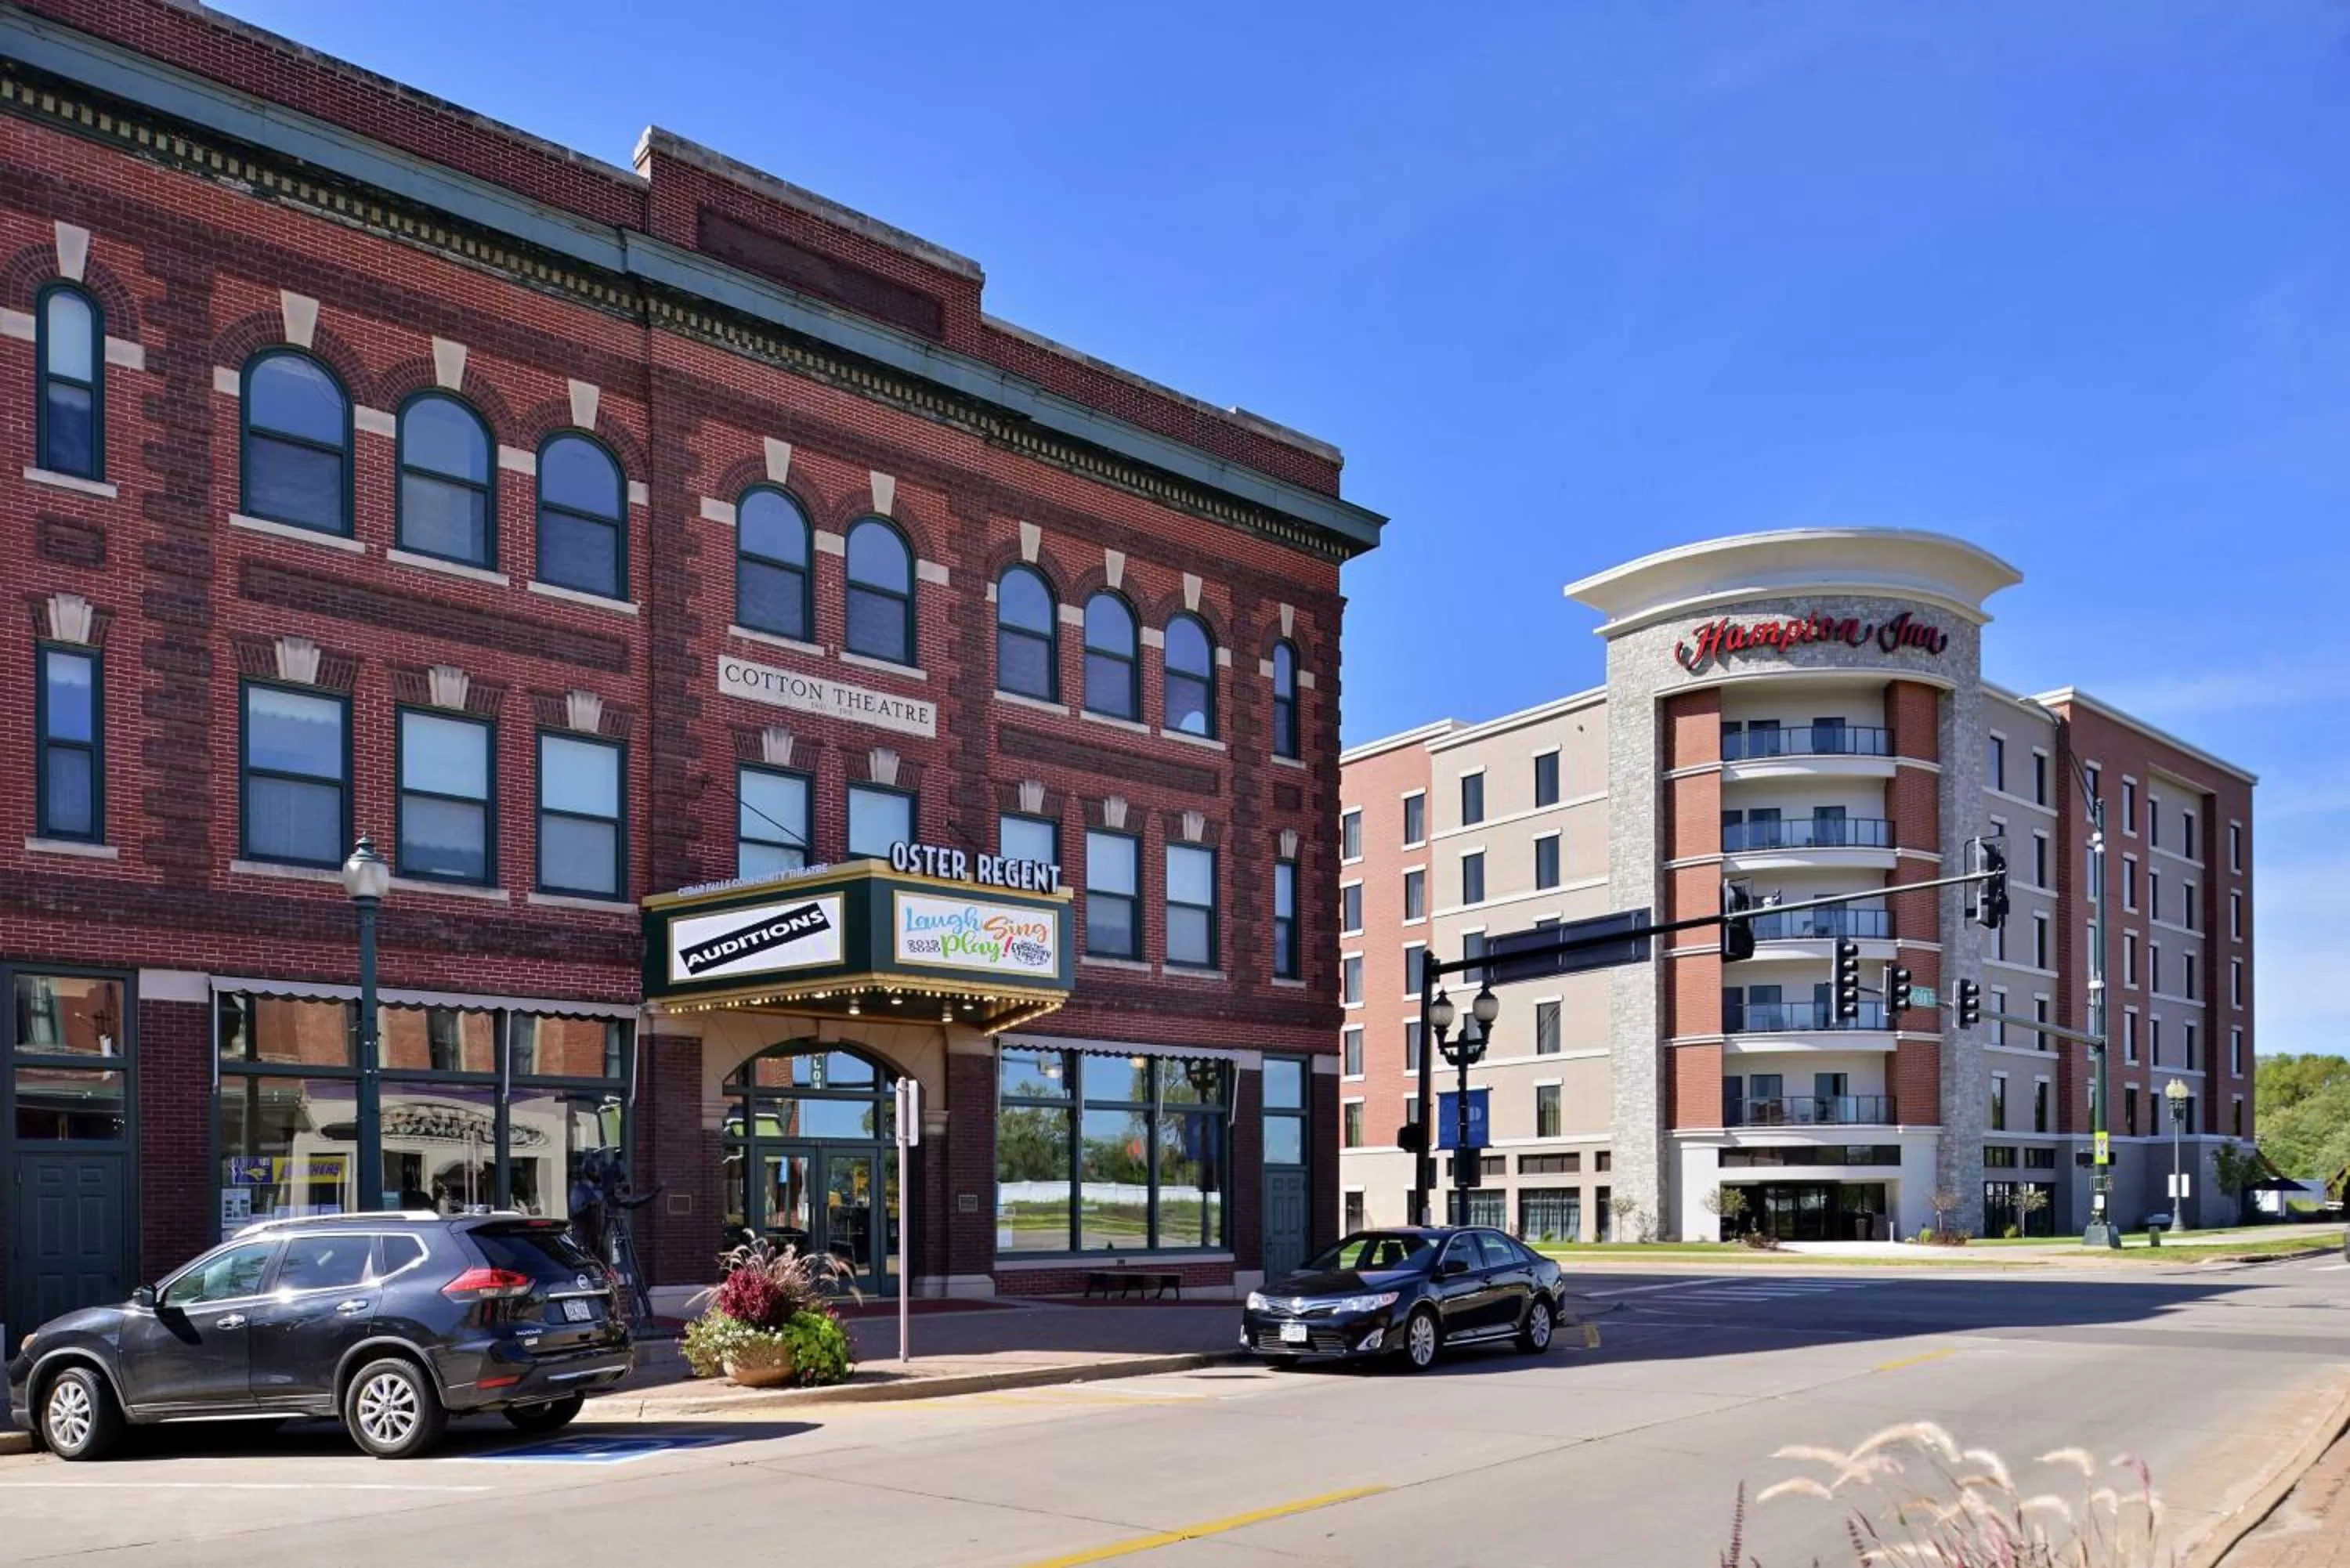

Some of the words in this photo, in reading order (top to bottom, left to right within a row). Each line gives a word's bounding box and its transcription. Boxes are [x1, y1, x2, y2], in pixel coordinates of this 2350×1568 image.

[1675, 611, 1874, 670] Hampton
[1879, 612, 1947, 655] Inn
[725, 664, 822, 700] COTTON
[833, 688, 929, 724] THEATRE
[891, 842, 967, 880] OSTER
[977, 853, 1061, 894] REGENT
[687, 909, 825, 968] AUDITIONS
[905, 906, 980, 934] Laugh
[982, 916, 1048, 943] Sing
